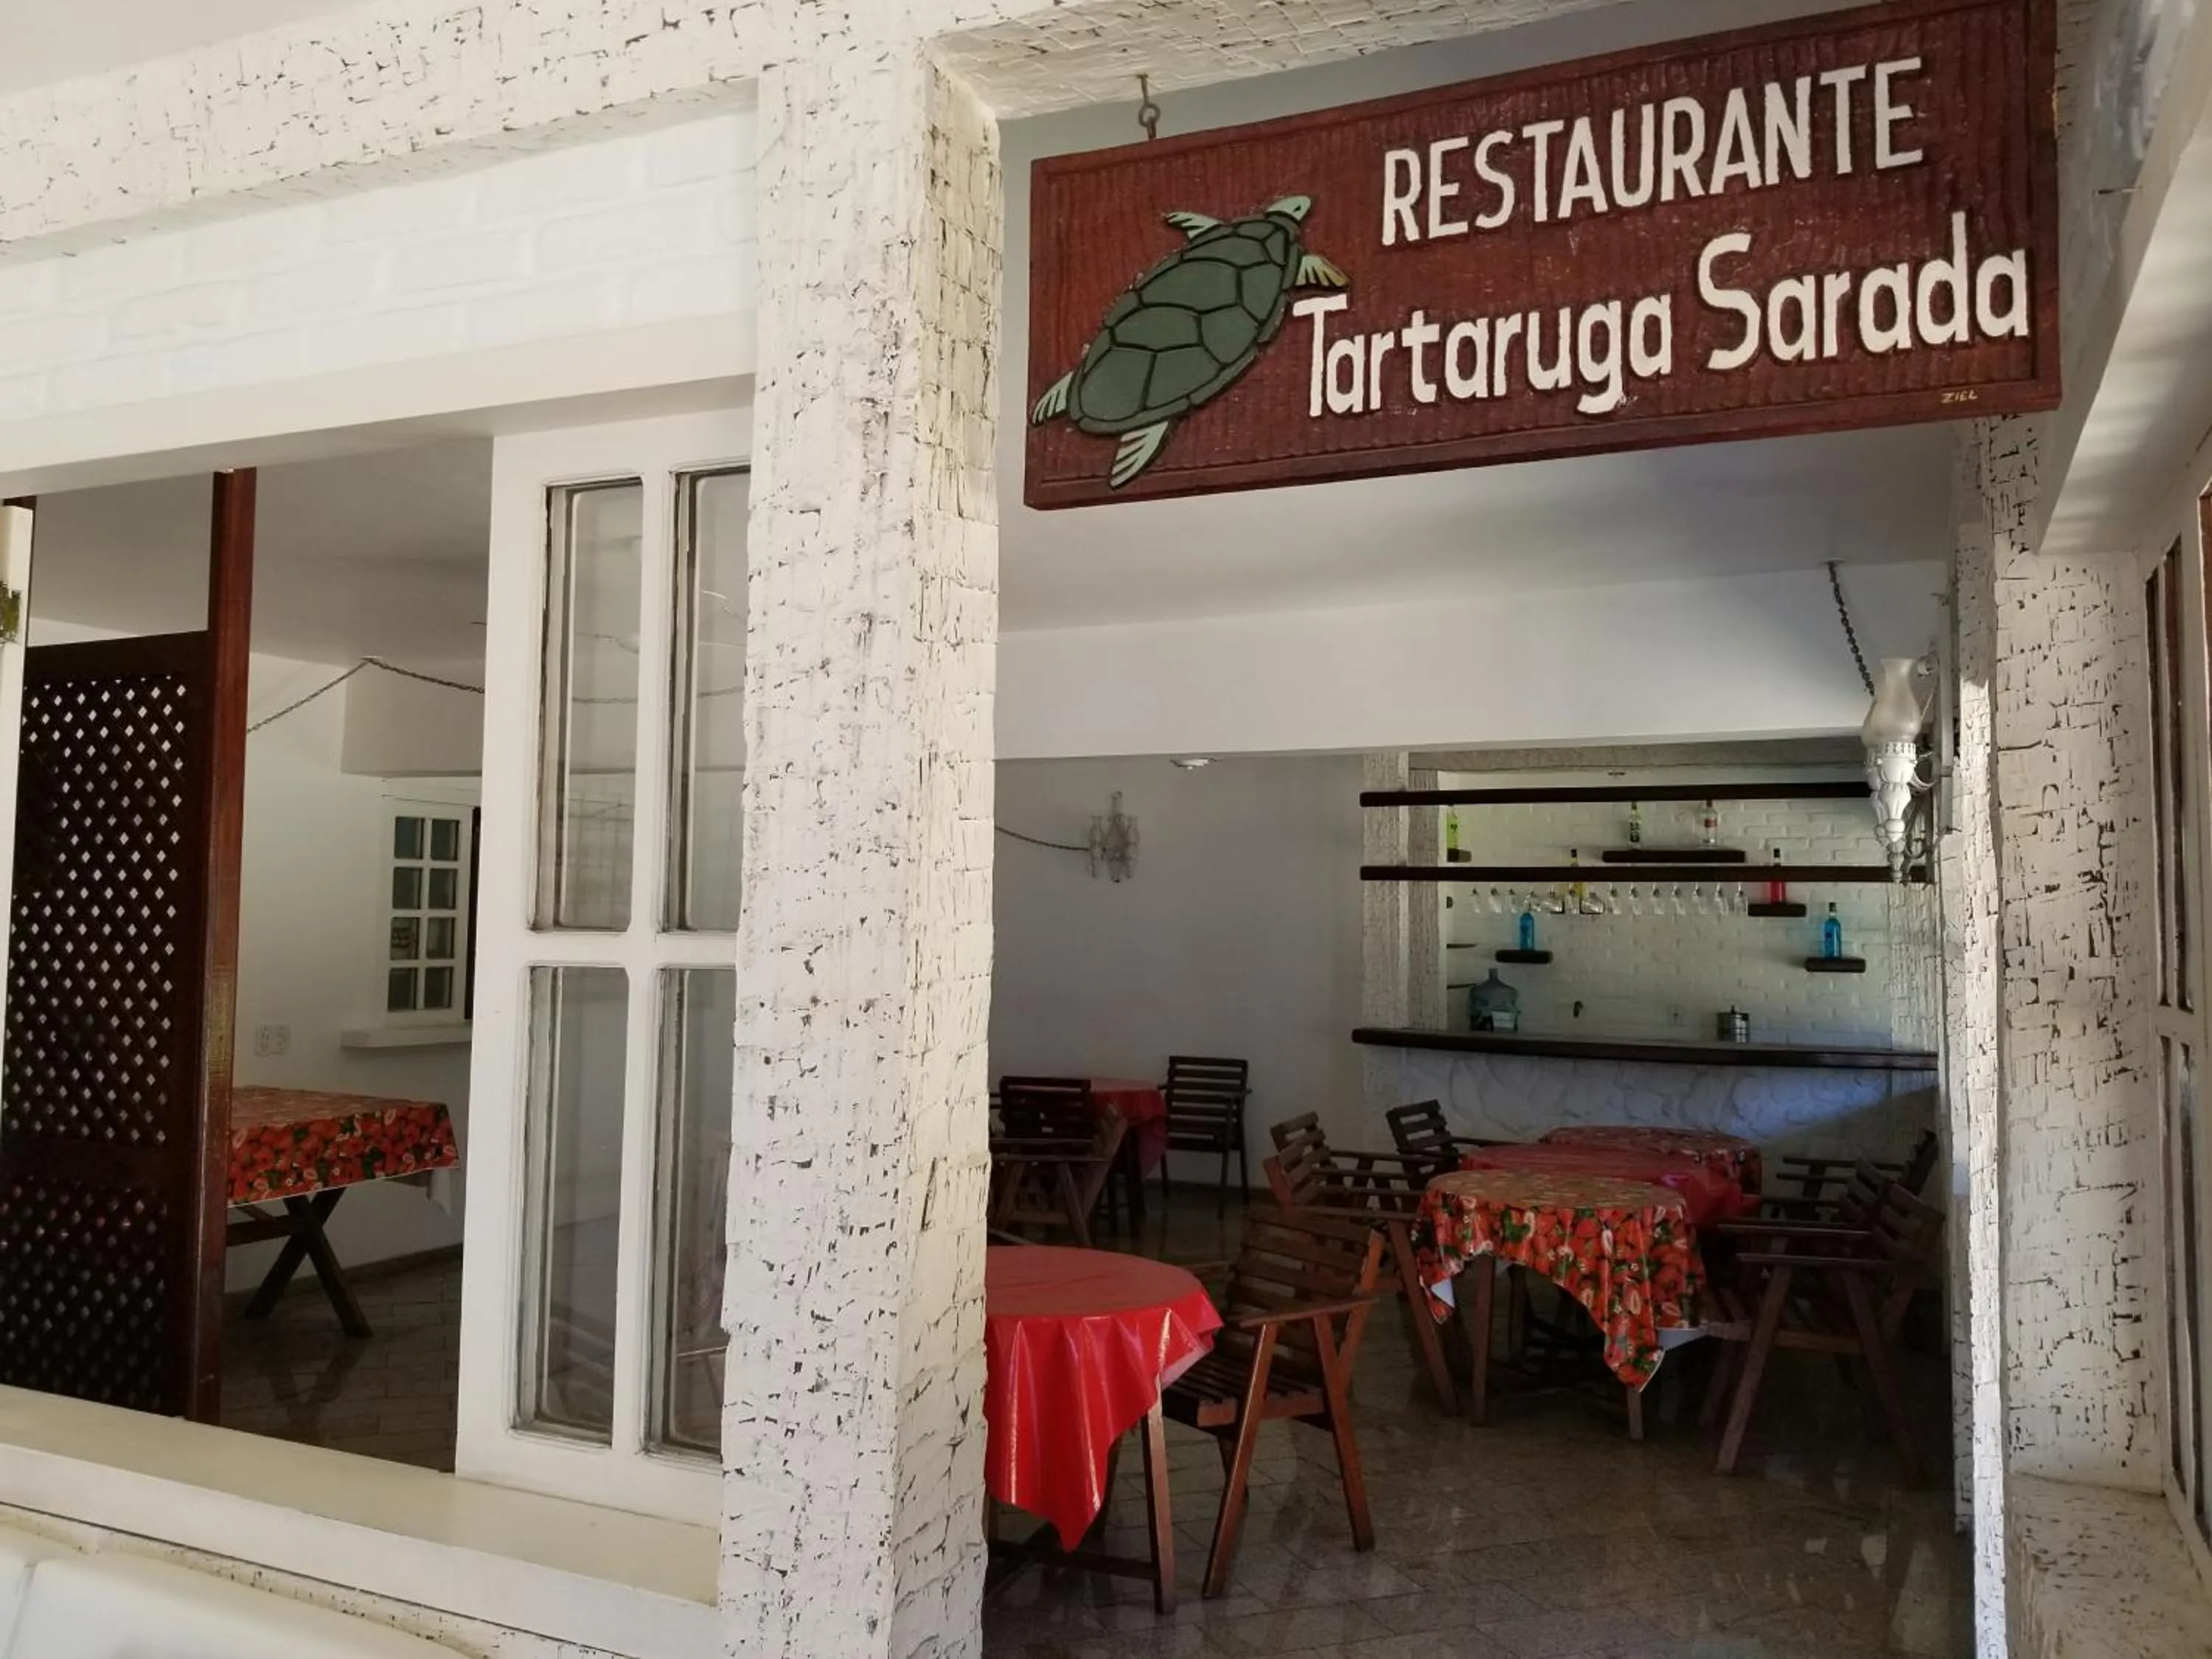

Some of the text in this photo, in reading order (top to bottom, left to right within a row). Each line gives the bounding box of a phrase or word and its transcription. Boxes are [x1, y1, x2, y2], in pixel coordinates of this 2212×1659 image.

[1382, 57, 1924, 246] RESTAURANTE
[1293, 211, 2029, 417] Tartaruga Sarada
[1940, 389, 1979, 403] ZIEL
